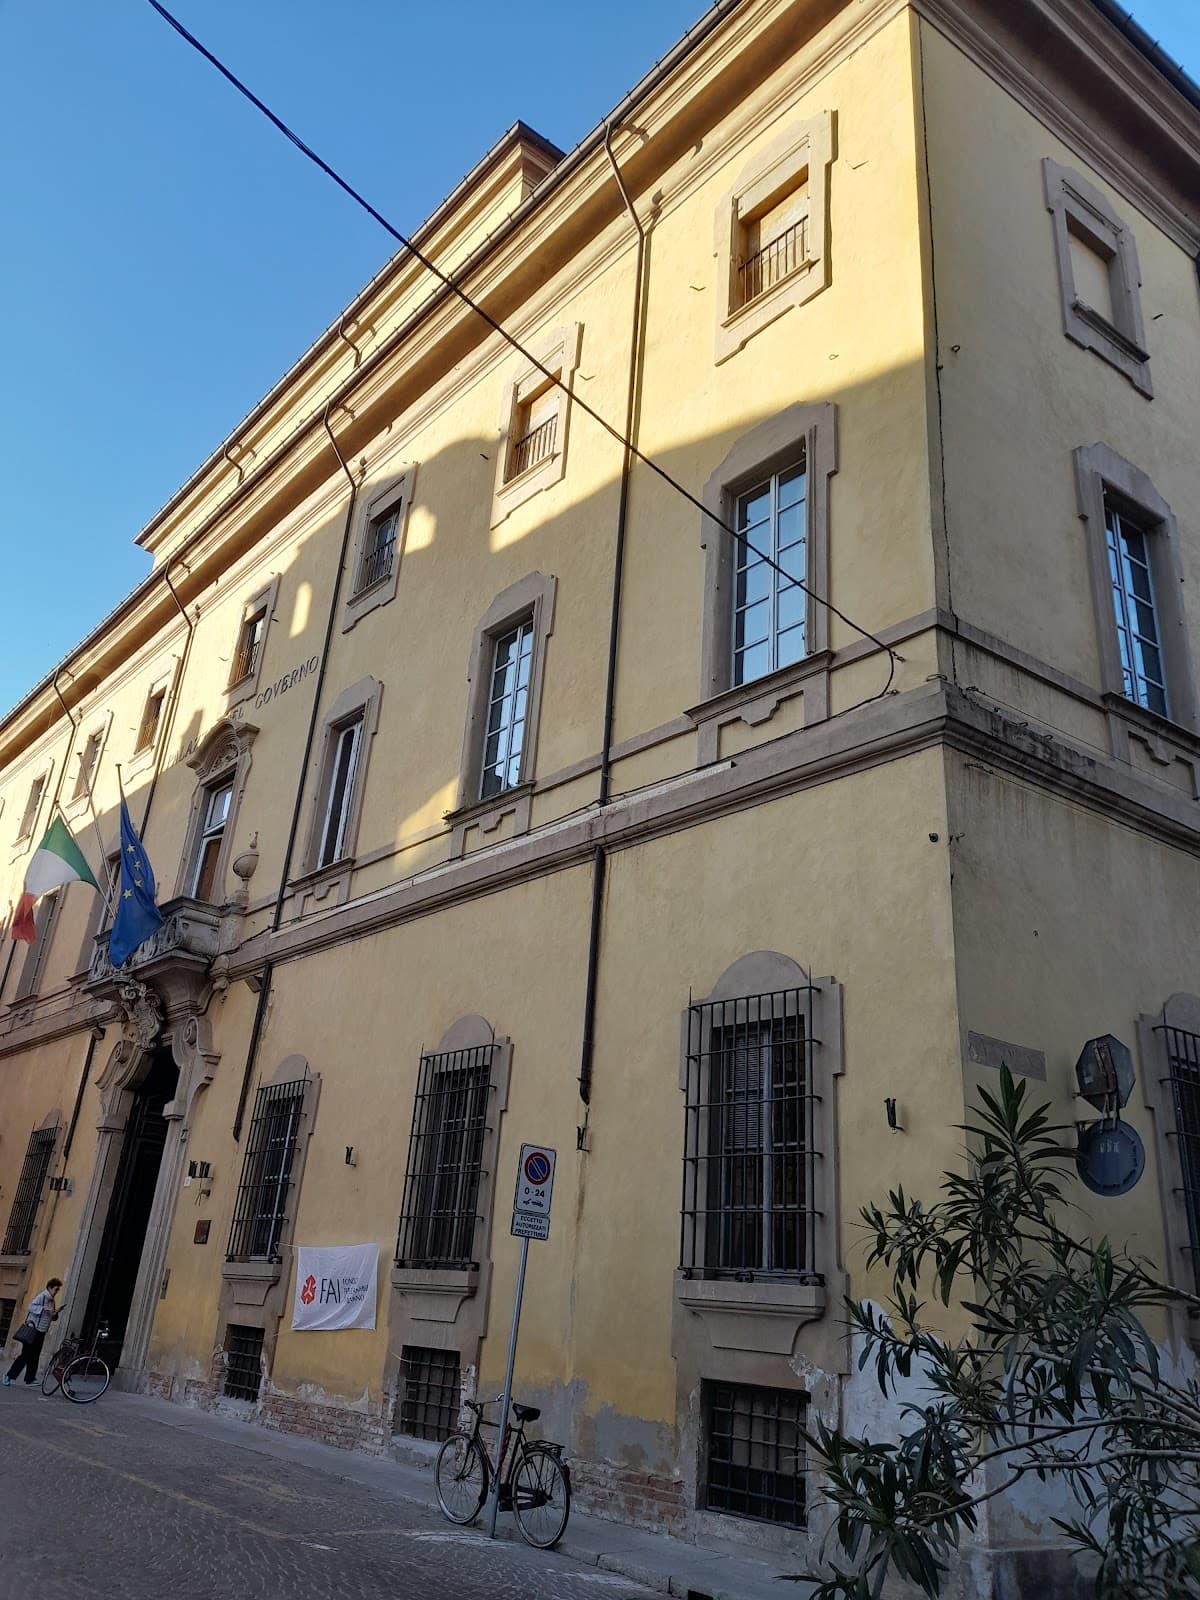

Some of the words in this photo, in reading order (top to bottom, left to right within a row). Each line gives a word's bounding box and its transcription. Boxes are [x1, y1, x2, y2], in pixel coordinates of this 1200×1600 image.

[229, 706, 245, 721] EL
[254, 655, 320, 710] GOVERNO
[520, 1215, 543, 1224] ECCETTO
[515, 1221, 546, 1231] AUTORIZZATI
[514, 1228, 546, 1238] PREFETTURA
[319, 1278, 341, 1304] FAI
